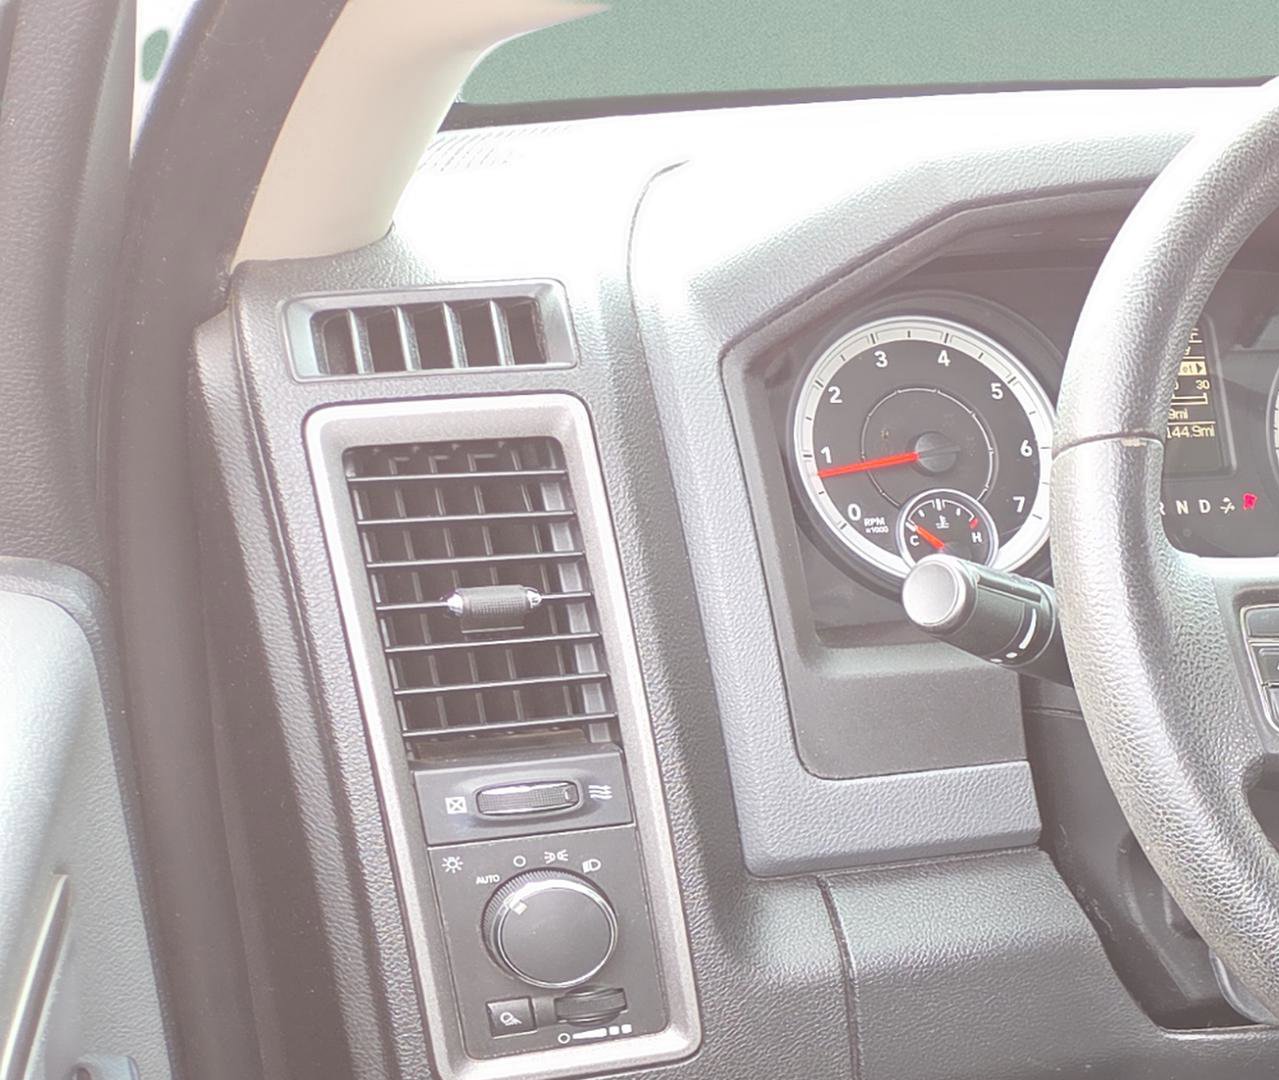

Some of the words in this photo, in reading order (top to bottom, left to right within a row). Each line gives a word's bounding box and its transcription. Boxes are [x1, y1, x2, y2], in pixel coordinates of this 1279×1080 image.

[874, 350, 888, 367] 3
[937, 350, 950, 366] 4
[828, 386, 842, 403] 2
[991, 383, 1003, 399] 5
[821, 446, 832, 464] 1
[1020, 440, 1032, 457] 6
[848, 503, 861, 521] 0
[1013, 496, 1025, 513] 7
[1176, 500, 1189, 515] N
[1199, 500, 1211, 513] D
[864, 516, 886, 527] RPM
[910, 535, 919, 546] C
[972, 532, 982, 543] H
[475, 873, 501, 885] AUTO
